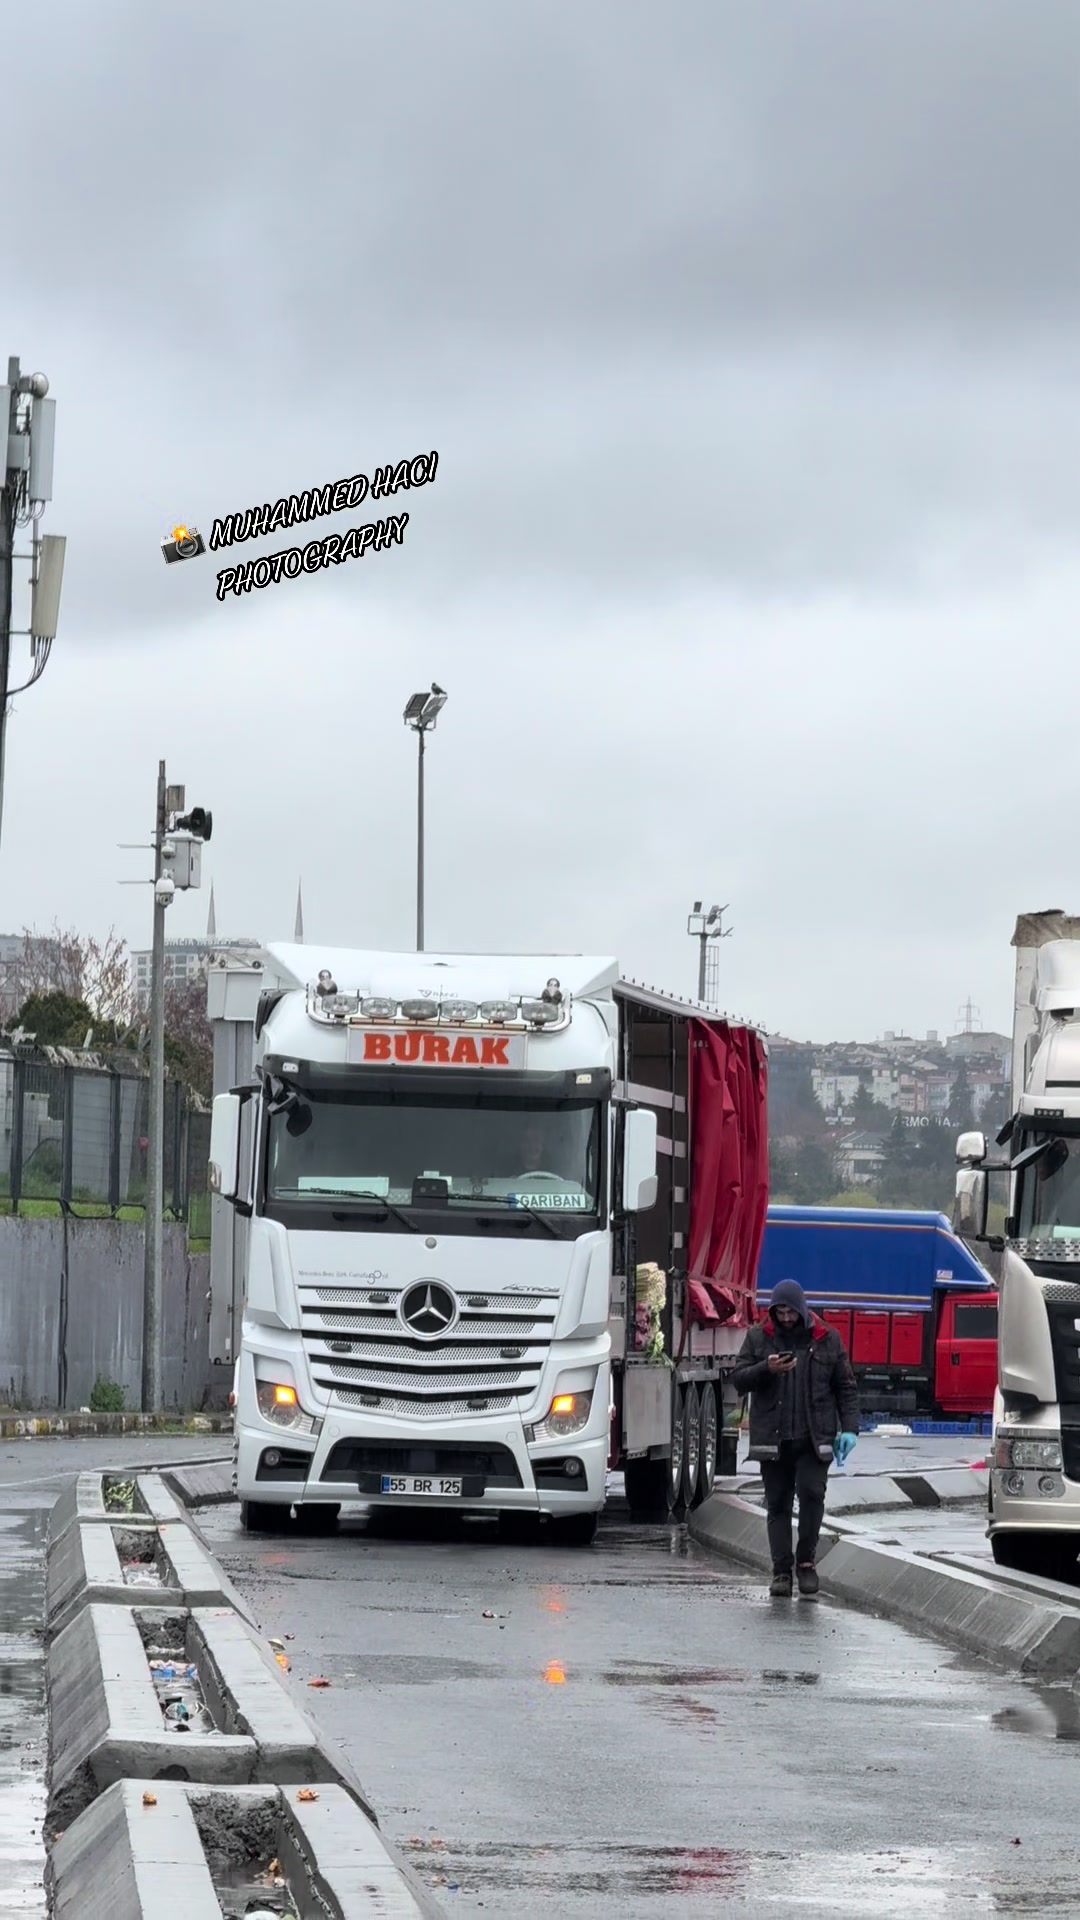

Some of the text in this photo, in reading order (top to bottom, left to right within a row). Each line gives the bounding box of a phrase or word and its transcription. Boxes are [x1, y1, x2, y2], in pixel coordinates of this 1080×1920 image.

[363, 1030, 510, 1066] BURAK
[390, 1478, 460, 1494] 55 BR 125
